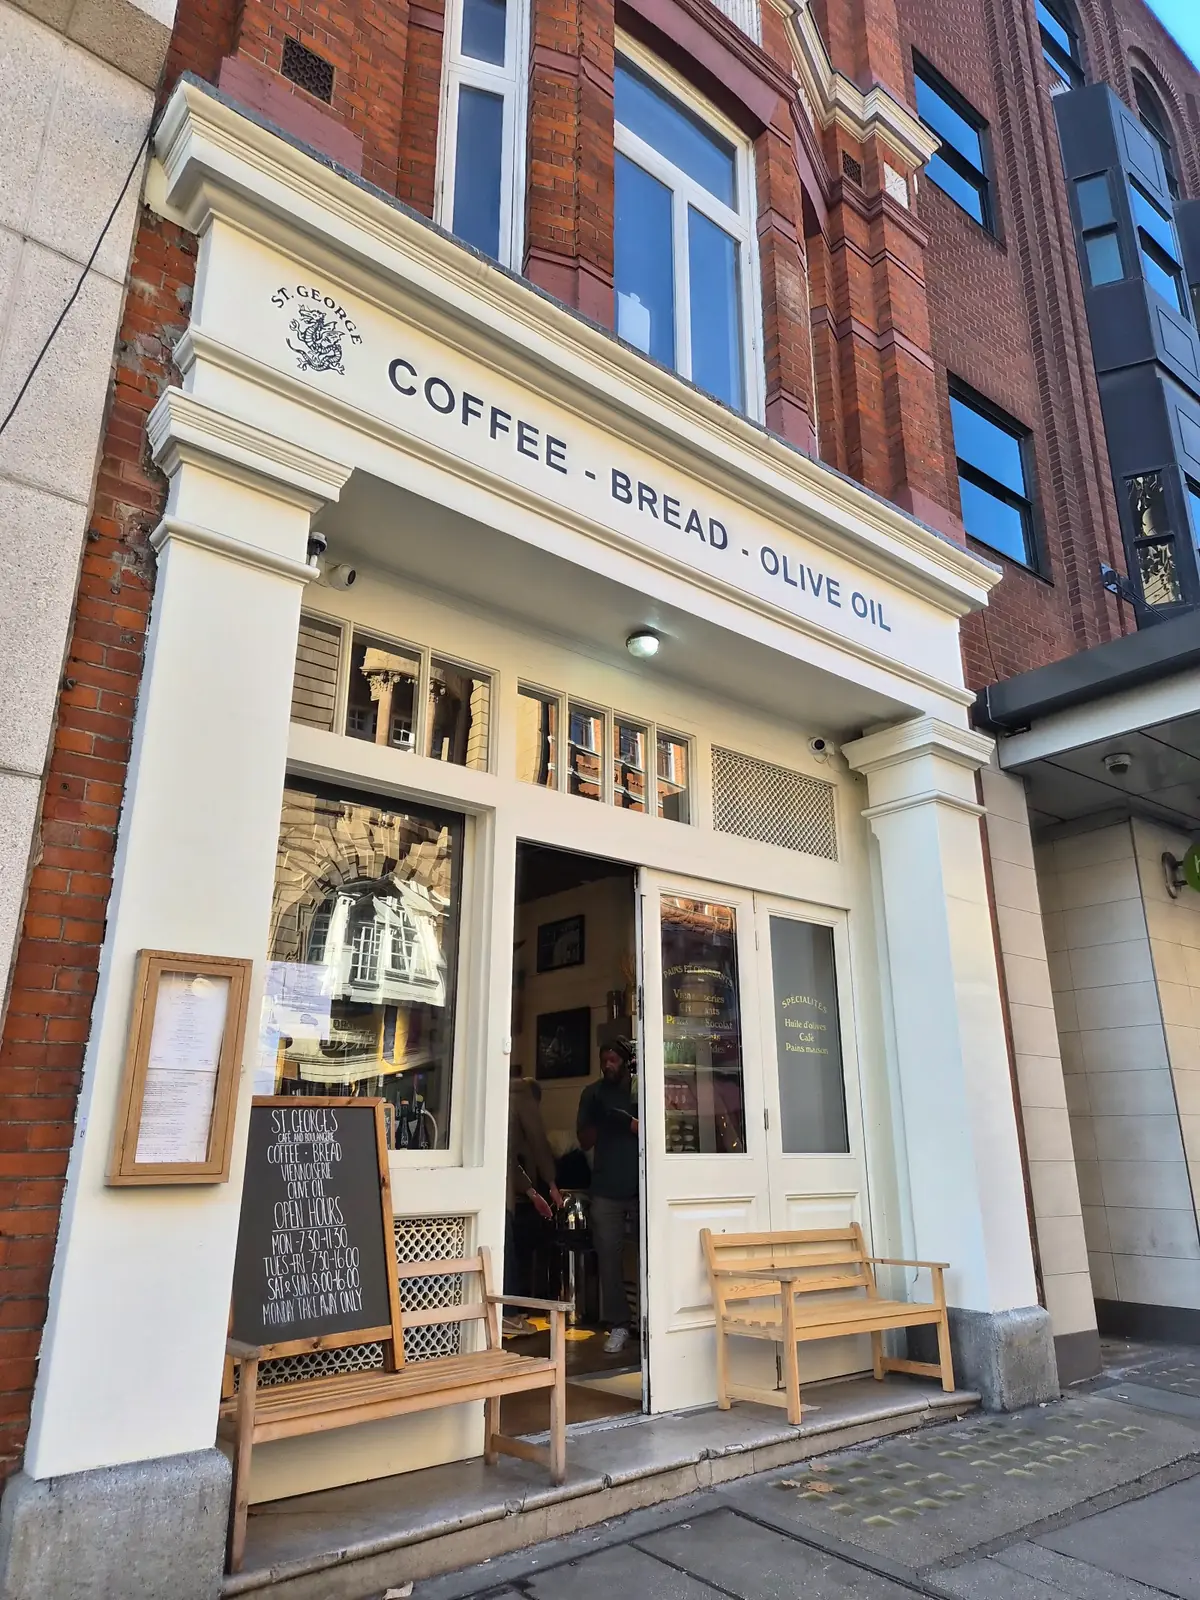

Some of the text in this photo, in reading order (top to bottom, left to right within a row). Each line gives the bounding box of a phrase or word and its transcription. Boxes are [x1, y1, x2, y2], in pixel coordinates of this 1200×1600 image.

[271, 285, 363, 345] ST. GEORGE
[388, 359, 568, 474] COFFEE
[611, 468, 728, 551] BREAD
[759, 545, 841, 608] OLIVE
[851, 591, 892, 633] OIL
[784, 1018, 803, 1029] Huile
[785, 1042, 829, 1056] Pains maison
[294, 1133, 304, 1142] AND
[267, 1143, 300, 1164] COFFEE
[312, 1142, 342, 1162] BREAD
[281, 1162, 333, 1181] VIENNOISERIE
[288, 1180, 326, 1199] OLIVE OIL
[274, 1196, 343, 1229] OPEN HOURS
[272, 1233, 293, 1255] MON
[263, 1299, 295, 1325] MONDAY
[340, 1288, 362, 1313] ONLY
